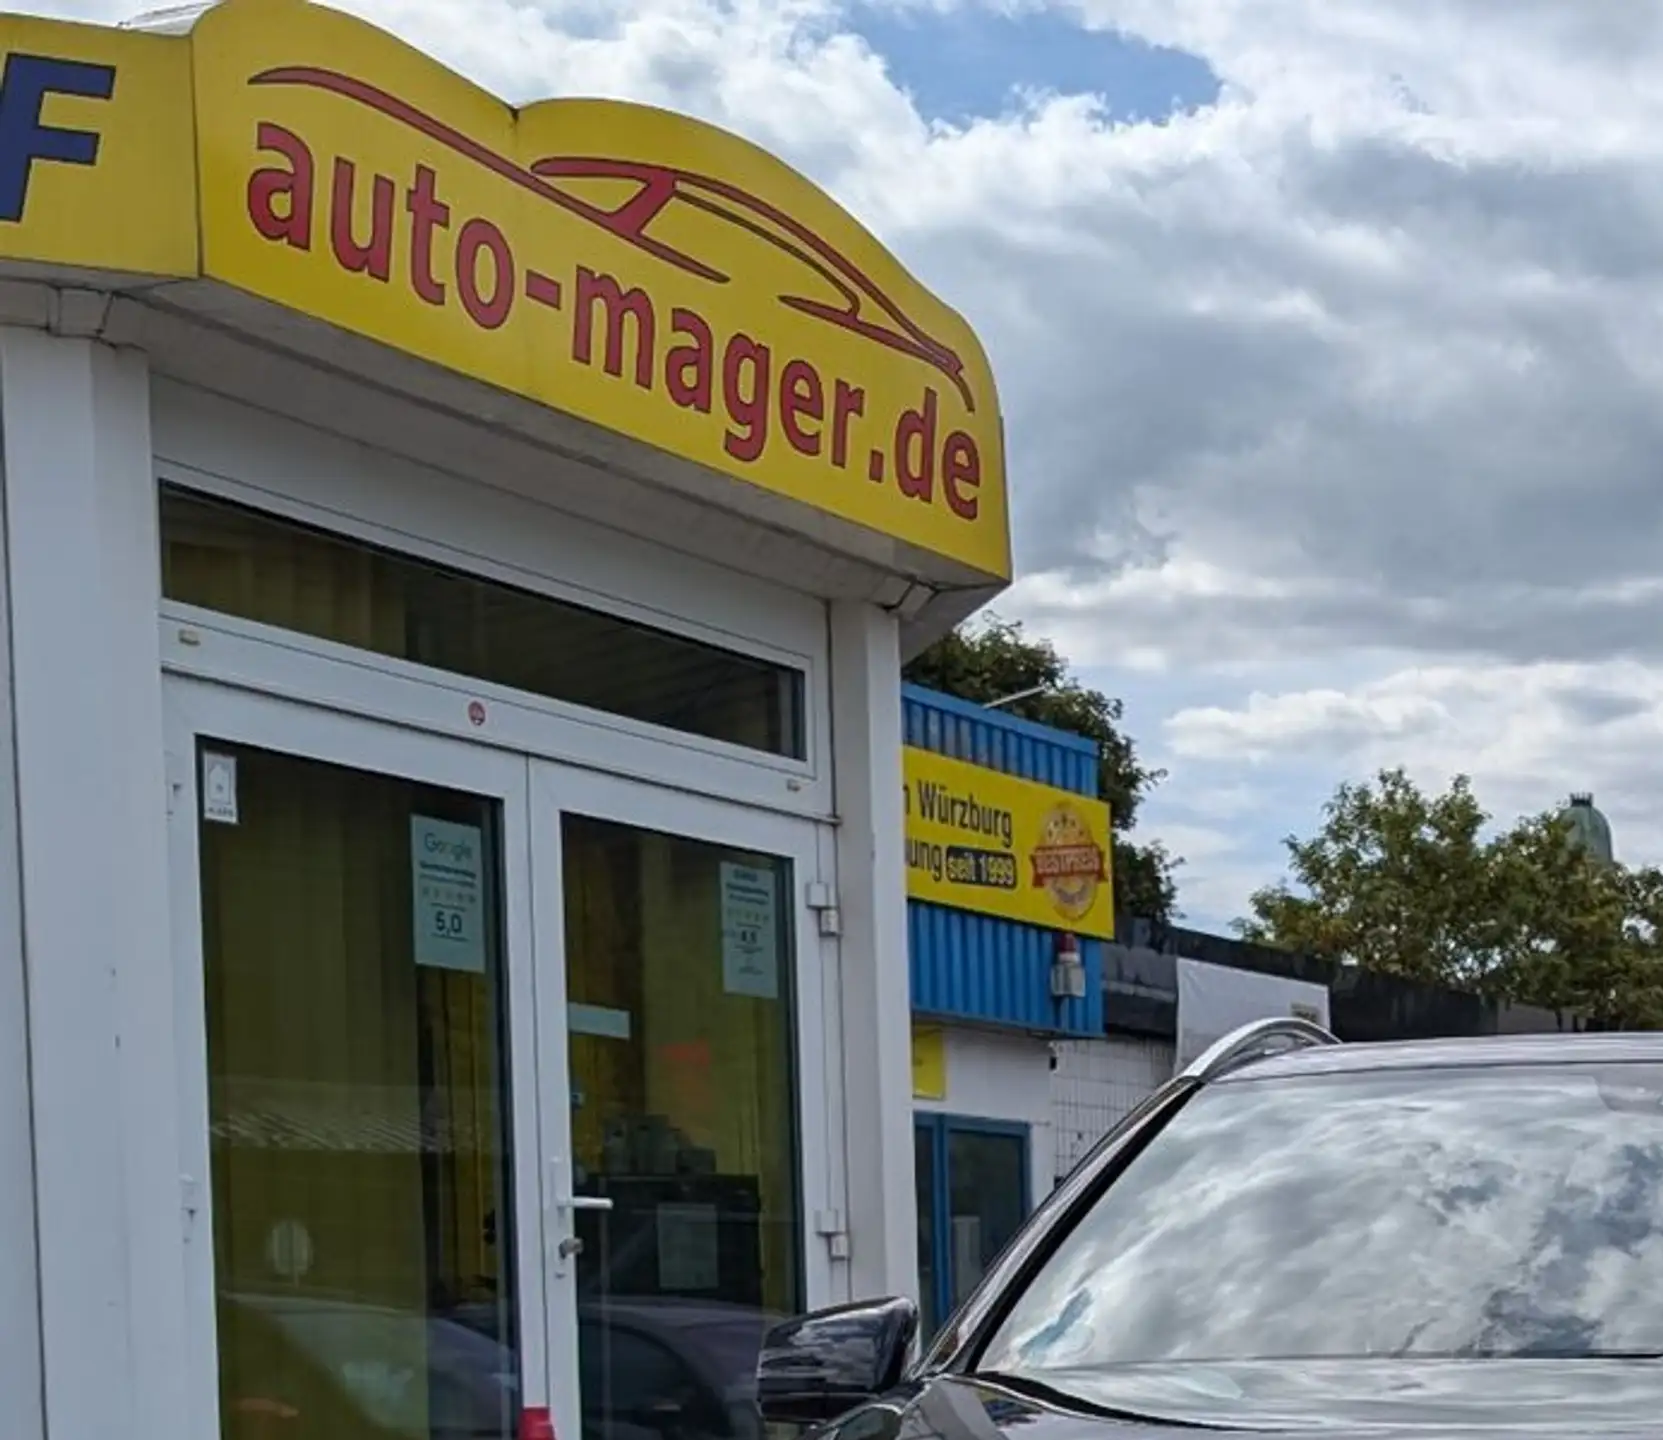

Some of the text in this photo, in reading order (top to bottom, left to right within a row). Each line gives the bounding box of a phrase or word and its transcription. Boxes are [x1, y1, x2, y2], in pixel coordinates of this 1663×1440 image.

[0, 52, 117, 223] F
[247, 120, 981, 521] auto-mager.de
[423, 831, 473, 861] Google
[917, 779, 1013, 849] Würzburg
[947, 851, 976, 882] seit
[978, 852, 1014, 886] 1999
